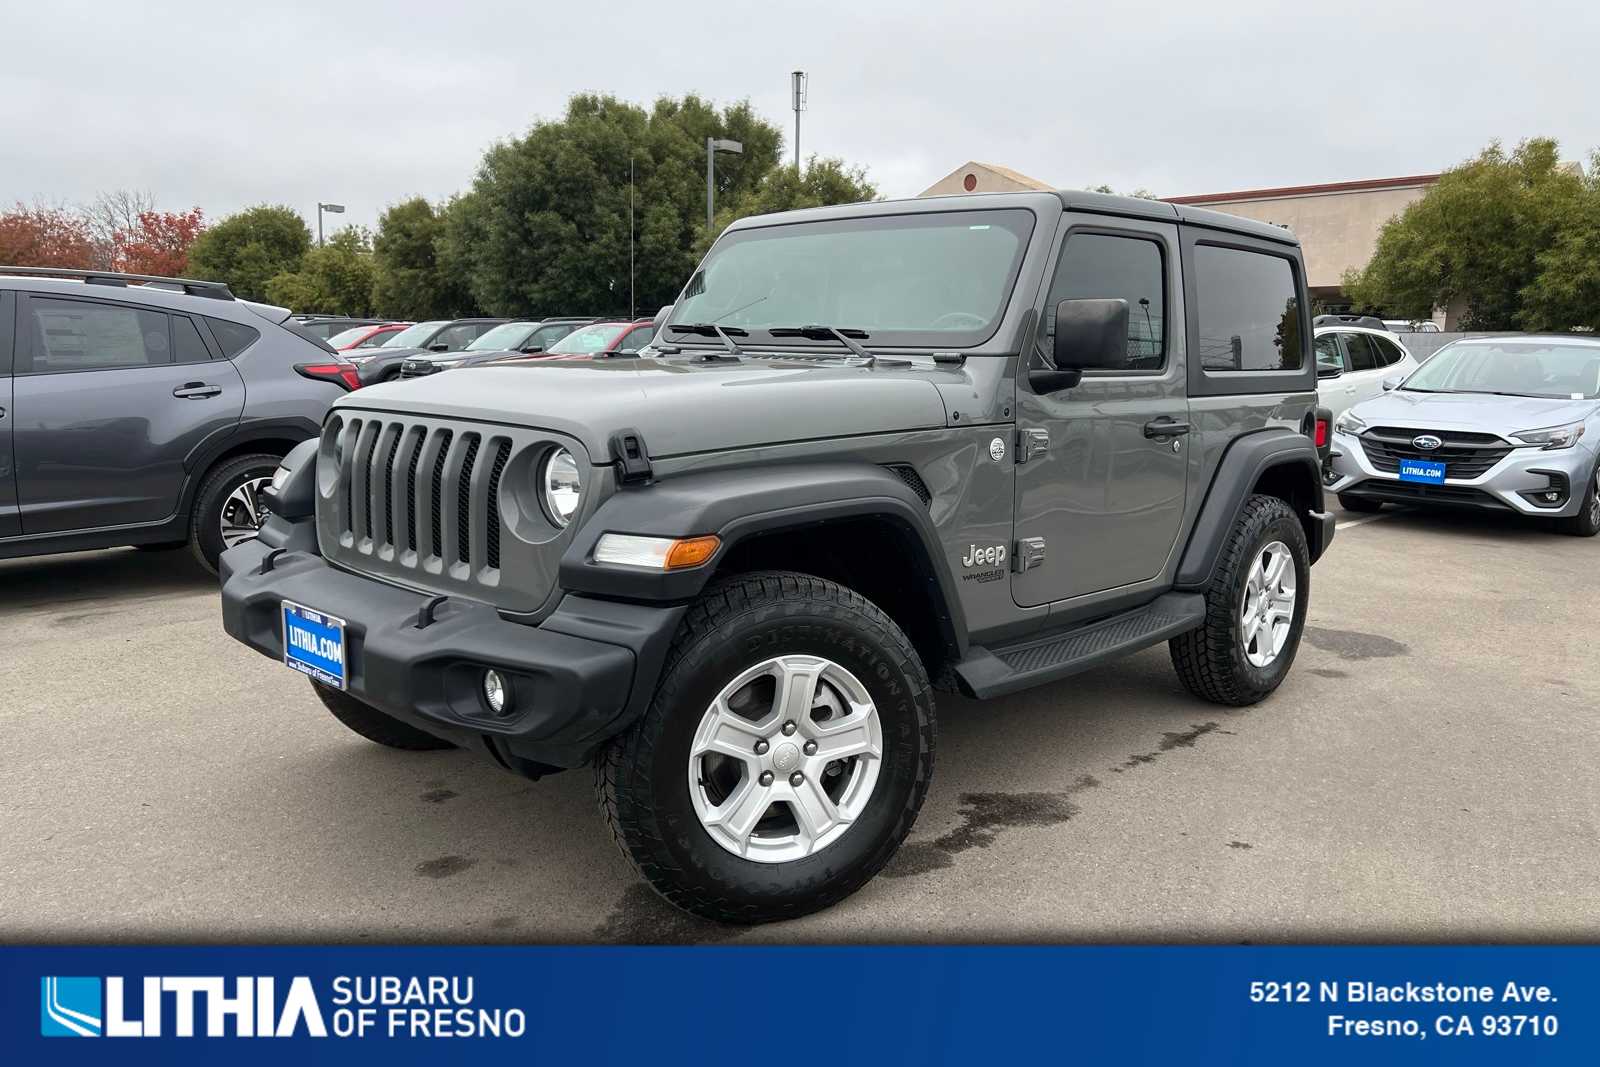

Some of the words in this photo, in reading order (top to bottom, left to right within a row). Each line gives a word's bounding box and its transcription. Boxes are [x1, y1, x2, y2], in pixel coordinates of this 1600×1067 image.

[1402, 467, 1441, 477] LITHIA.COM
[962, 544, 1006, 567] Jeep
[289, 625, 342, 664] LITHIA.COM
